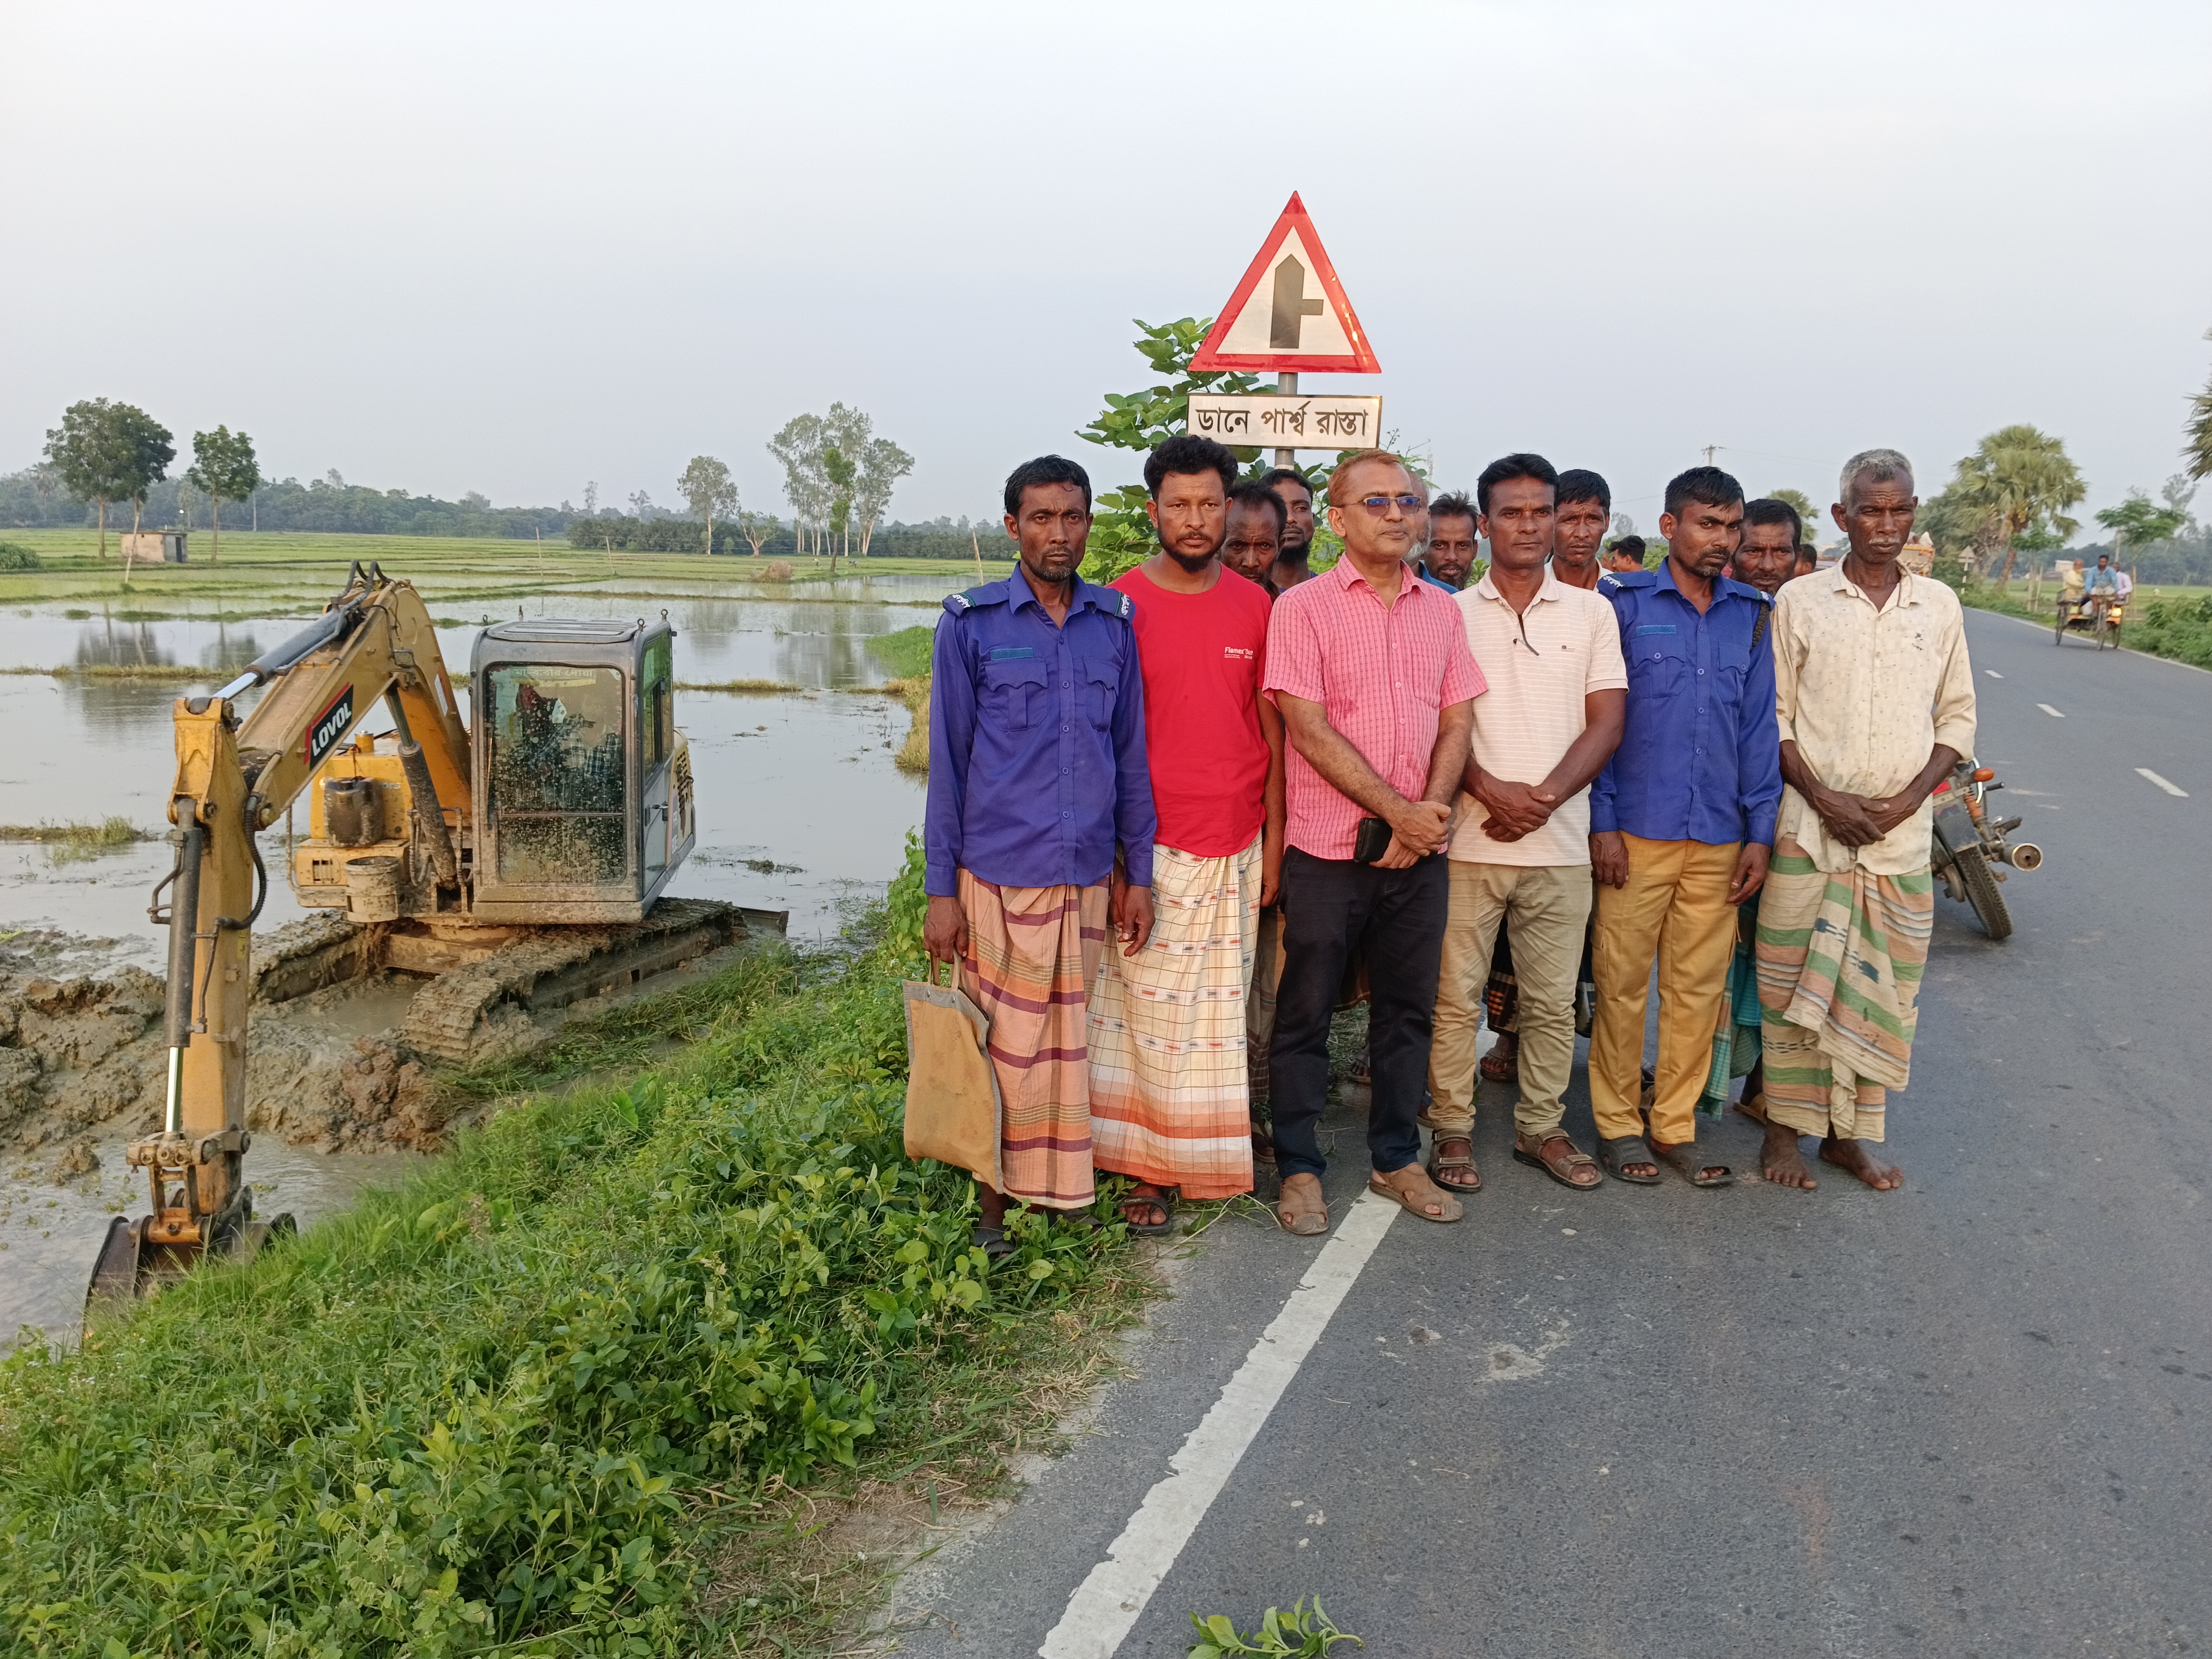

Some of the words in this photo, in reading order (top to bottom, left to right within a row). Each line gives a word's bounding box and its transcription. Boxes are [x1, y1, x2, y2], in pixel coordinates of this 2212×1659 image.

[1195, 407, 1250, 434] ডানে
[1261, 401, 1311, 436] পার্শ্ব
[1315, 409, 1369, 436] রাস্তা
[312, 703, 351, 757] LOVOL
